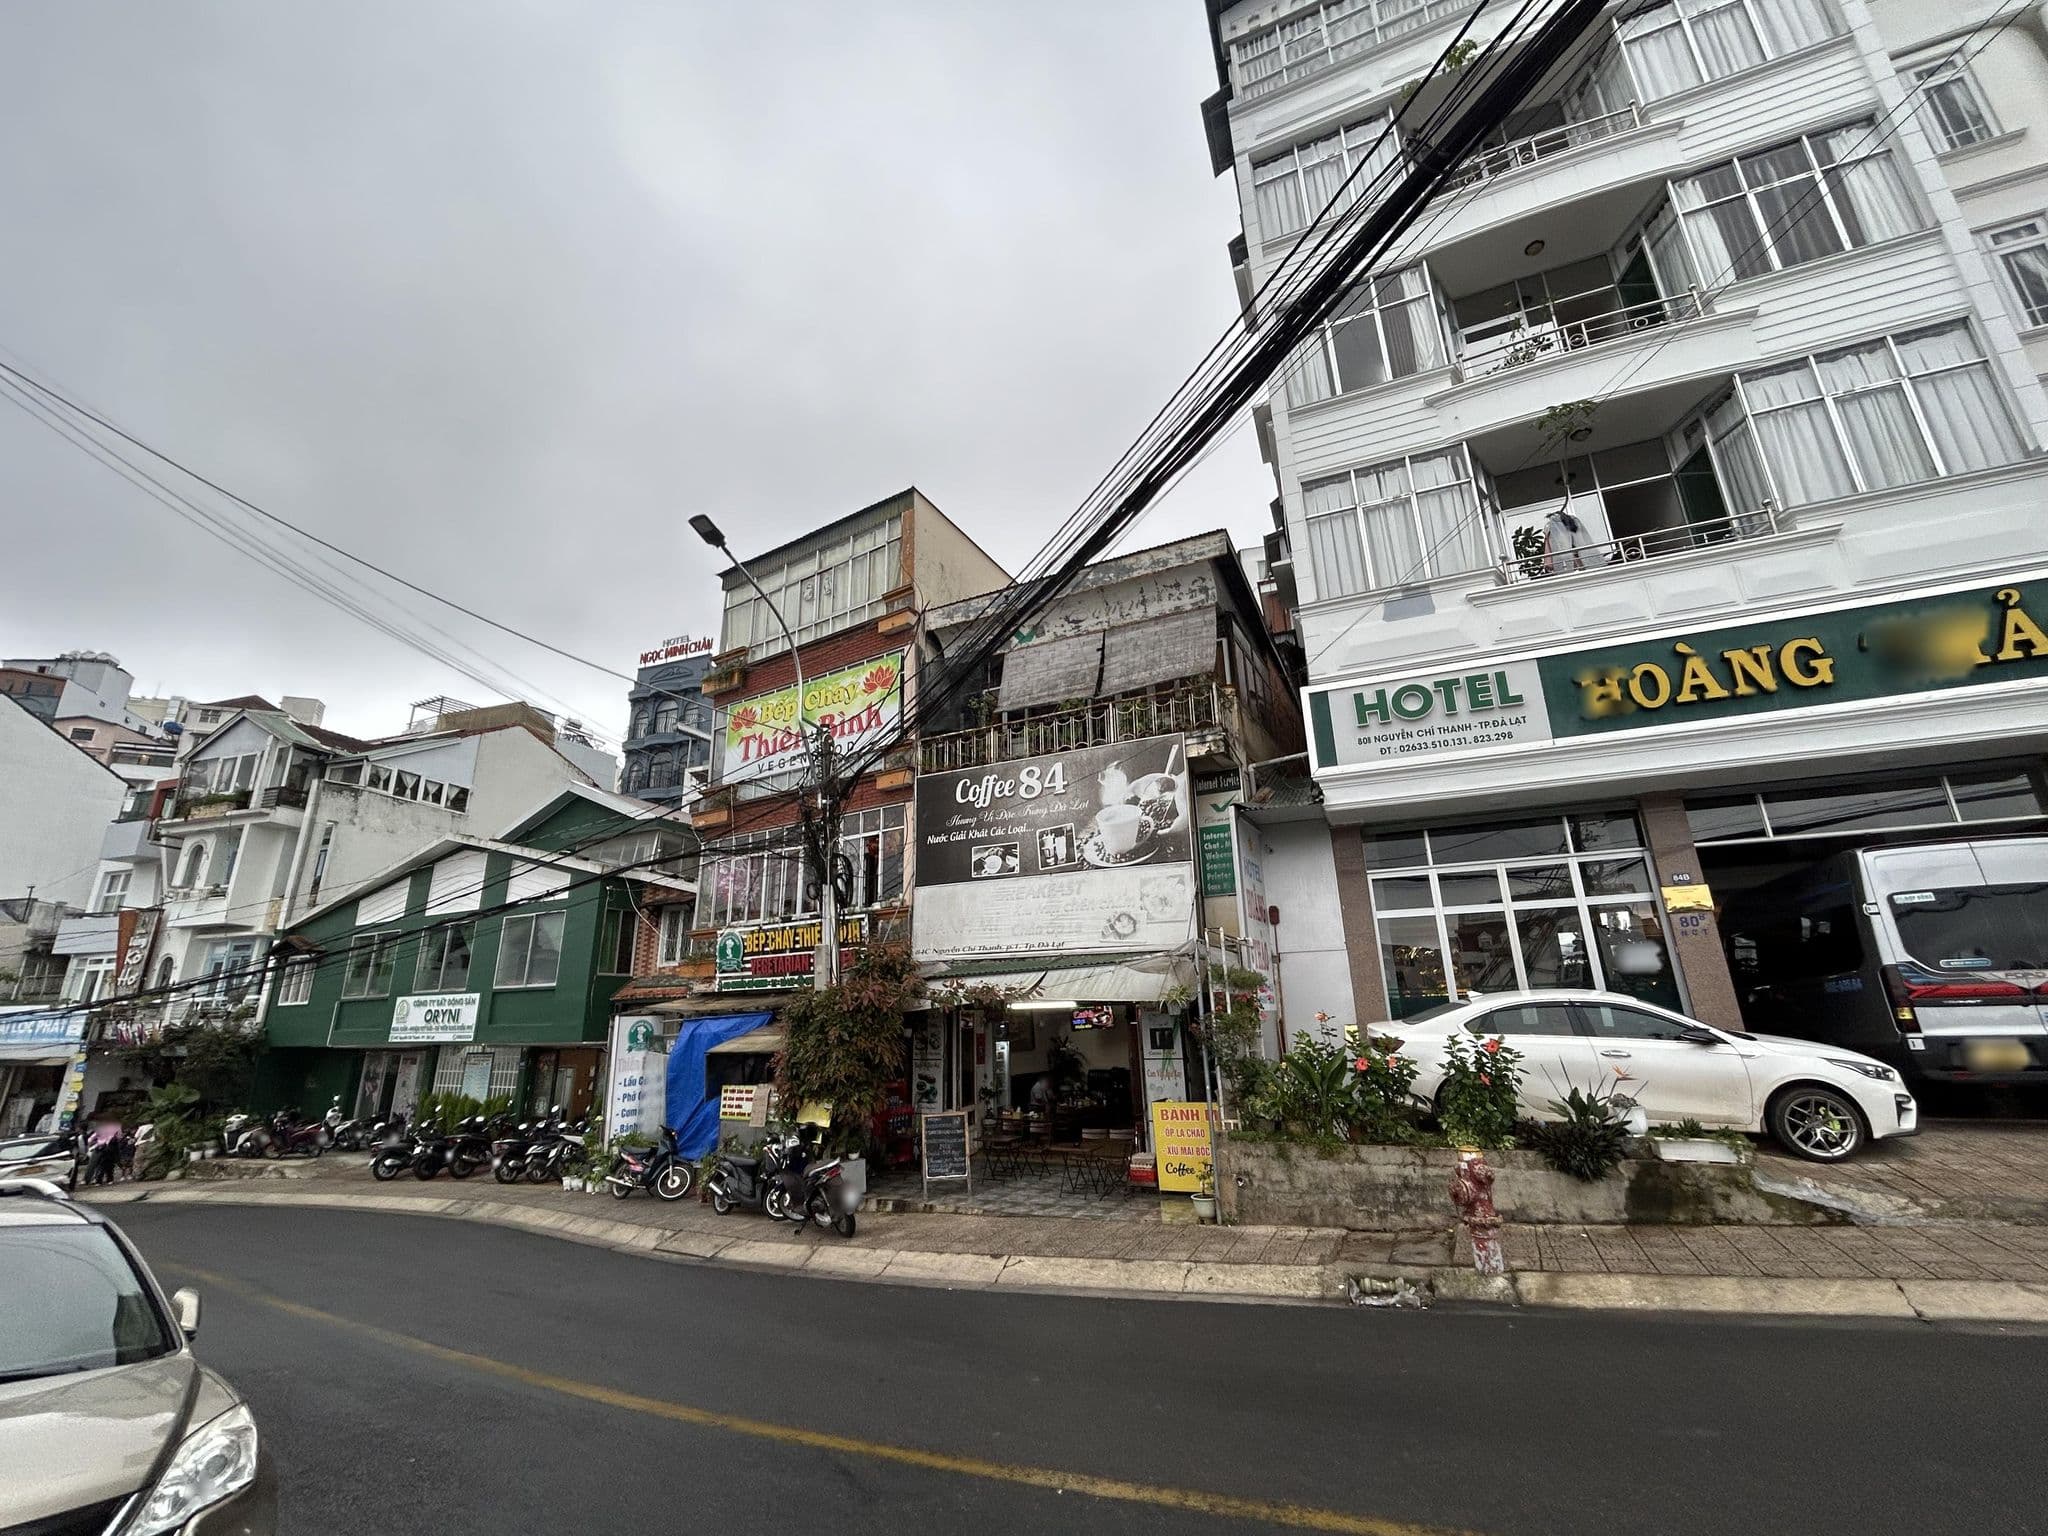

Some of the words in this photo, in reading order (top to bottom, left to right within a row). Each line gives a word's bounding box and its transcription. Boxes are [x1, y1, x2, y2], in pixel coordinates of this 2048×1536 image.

[663, 634, 691, 647] HOTEL
[760, 694, 799, 723] Bếp
[803, 682, 859, 711] Chay
[1353, 671, 1526, 728] HOTEL
[1374, 729, 1413, 744] NGUYỄN
[1416, 725, 1436, 738] CHÍ
[1437, 722, 1472, 736] THANH
[1508, 715, 1527, 727] LẠT
[955, 774, 1015, 809] Coffee
[1018, 762, 1068, 799] 84
[927, 833, 949, 845] Nước
[746, 930, 766, 953] BẾP
[751, 953, 810, 975] VEGETARIAN
[424, 1008, 462, 1023] ORYNI
